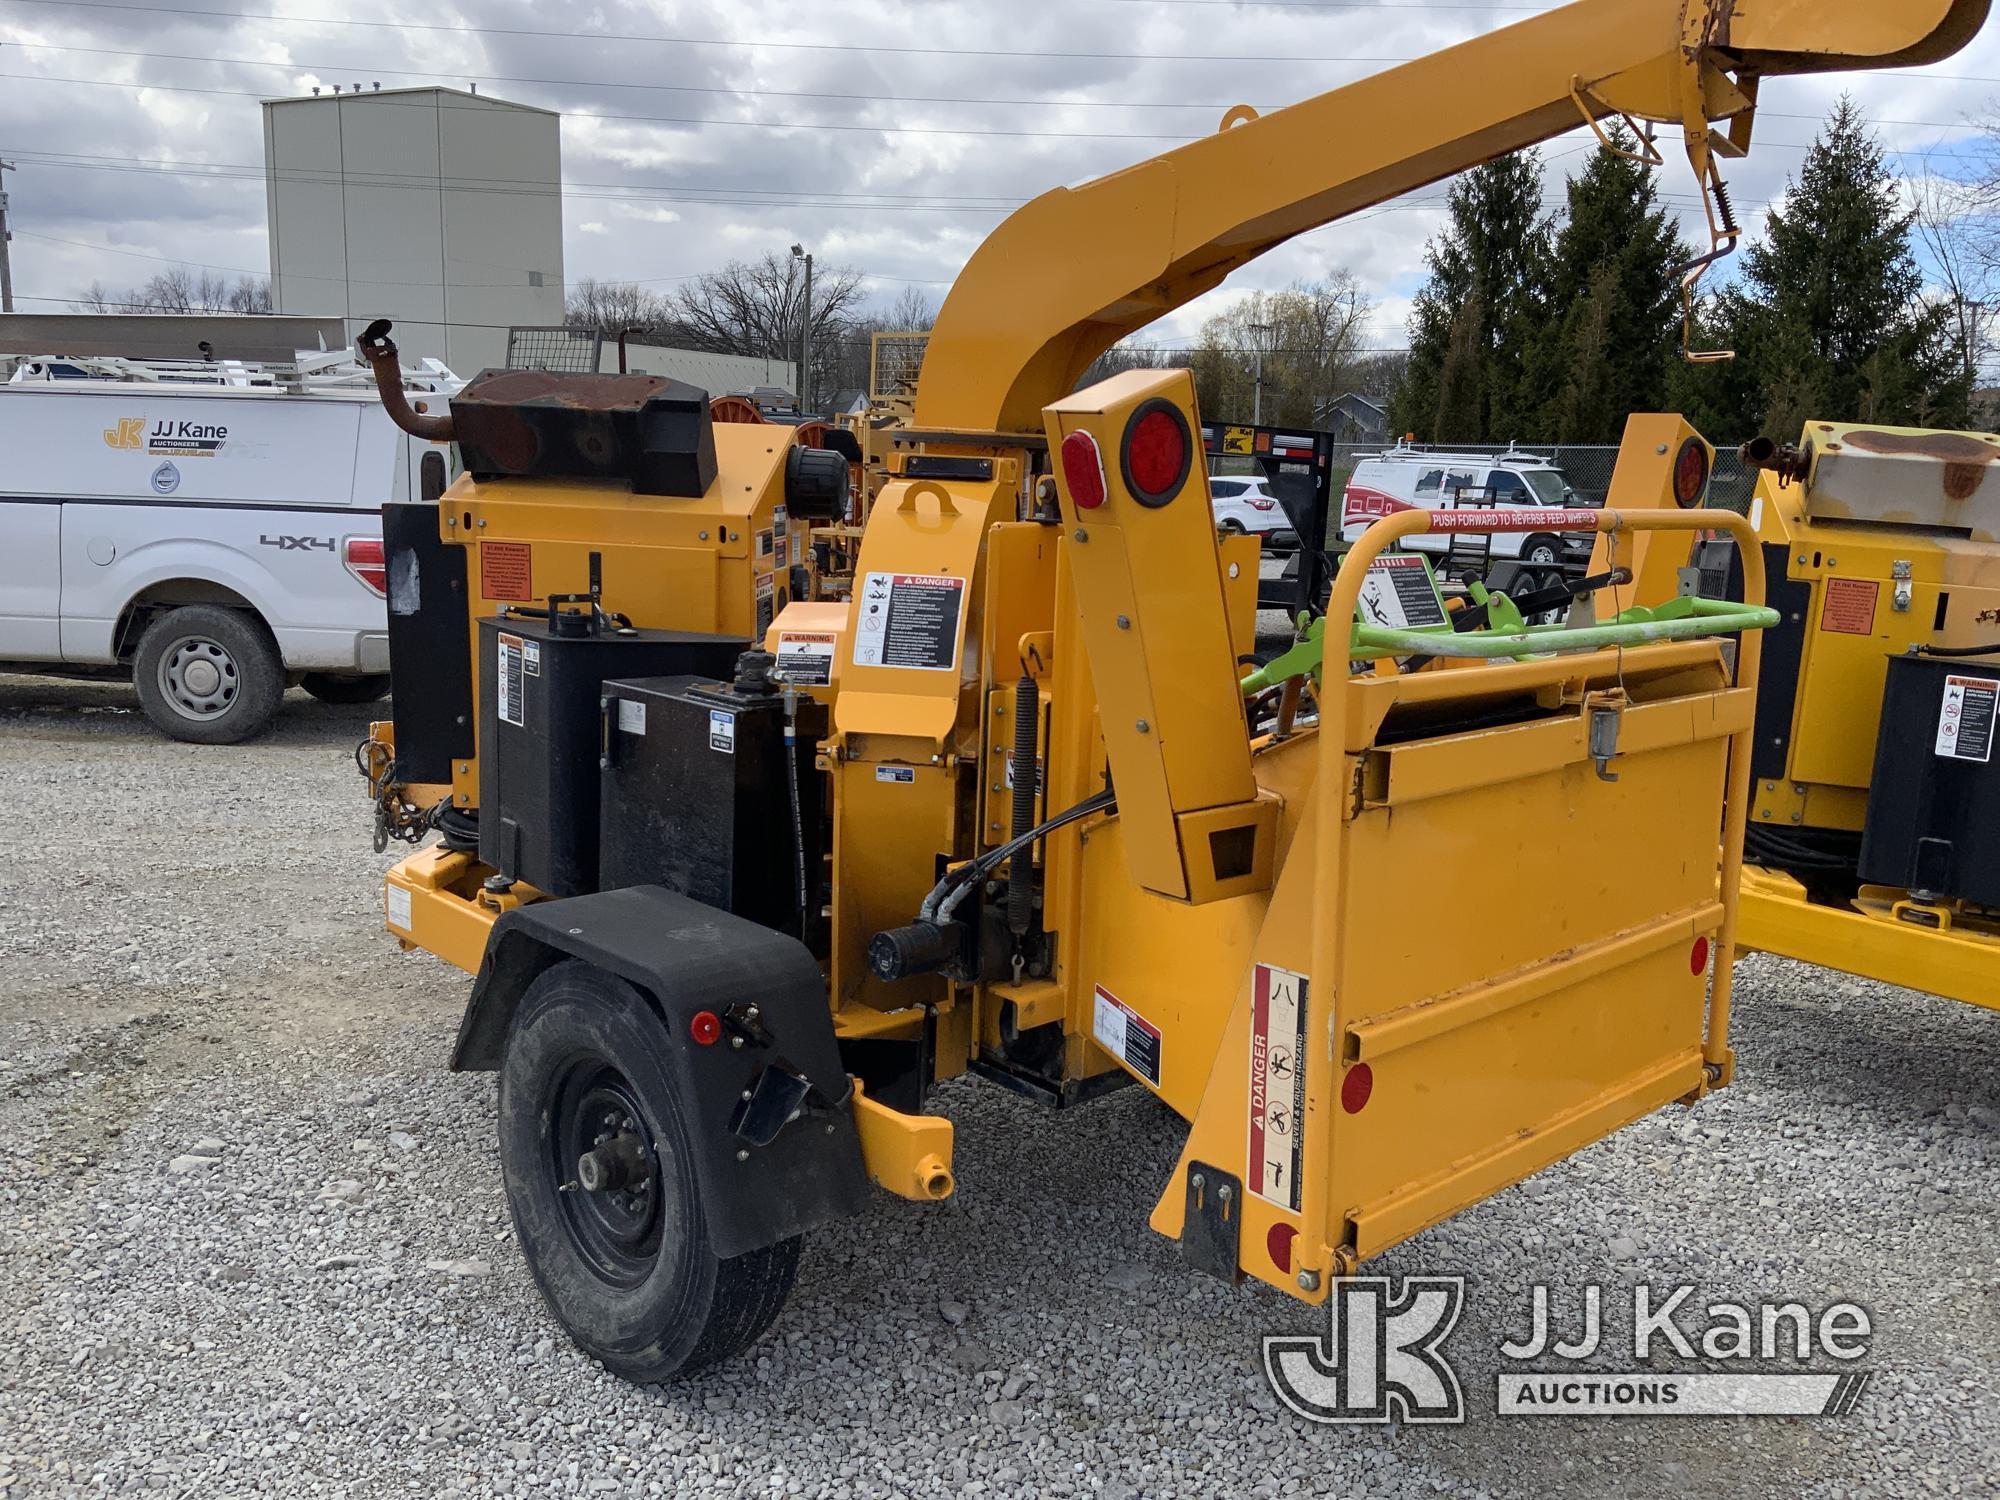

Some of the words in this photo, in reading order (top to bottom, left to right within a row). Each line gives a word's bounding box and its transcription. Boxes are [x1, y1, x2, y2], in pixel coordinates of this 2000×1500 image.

[151, 421, 174, 437] JJ
[178, 421, 228, 438] Kane
[1432, 514, 1456, 527] PUSH
[1457, 513, 1498, 526] FORWARD
[1499, 513, 1511, 526] TO
[1512, 512, 1546, 525] REVERSE
[1548, 512, 1566, 525] FEED
[1375, 559, 1406, 567] DANGER
[914, 578, 954, 586] DANGER
[1959, 679, 1996, 689] WARNING
[1295, 1033, 1303, 1073] HAZARD
[1252, 1033, 1267, 1109] DANGER
[1293, 1074, 1301, 1108] CRUSH
[1293, 1109, 1300, 1117] &
[1292, 1118, 1300, 1150] SEVER
